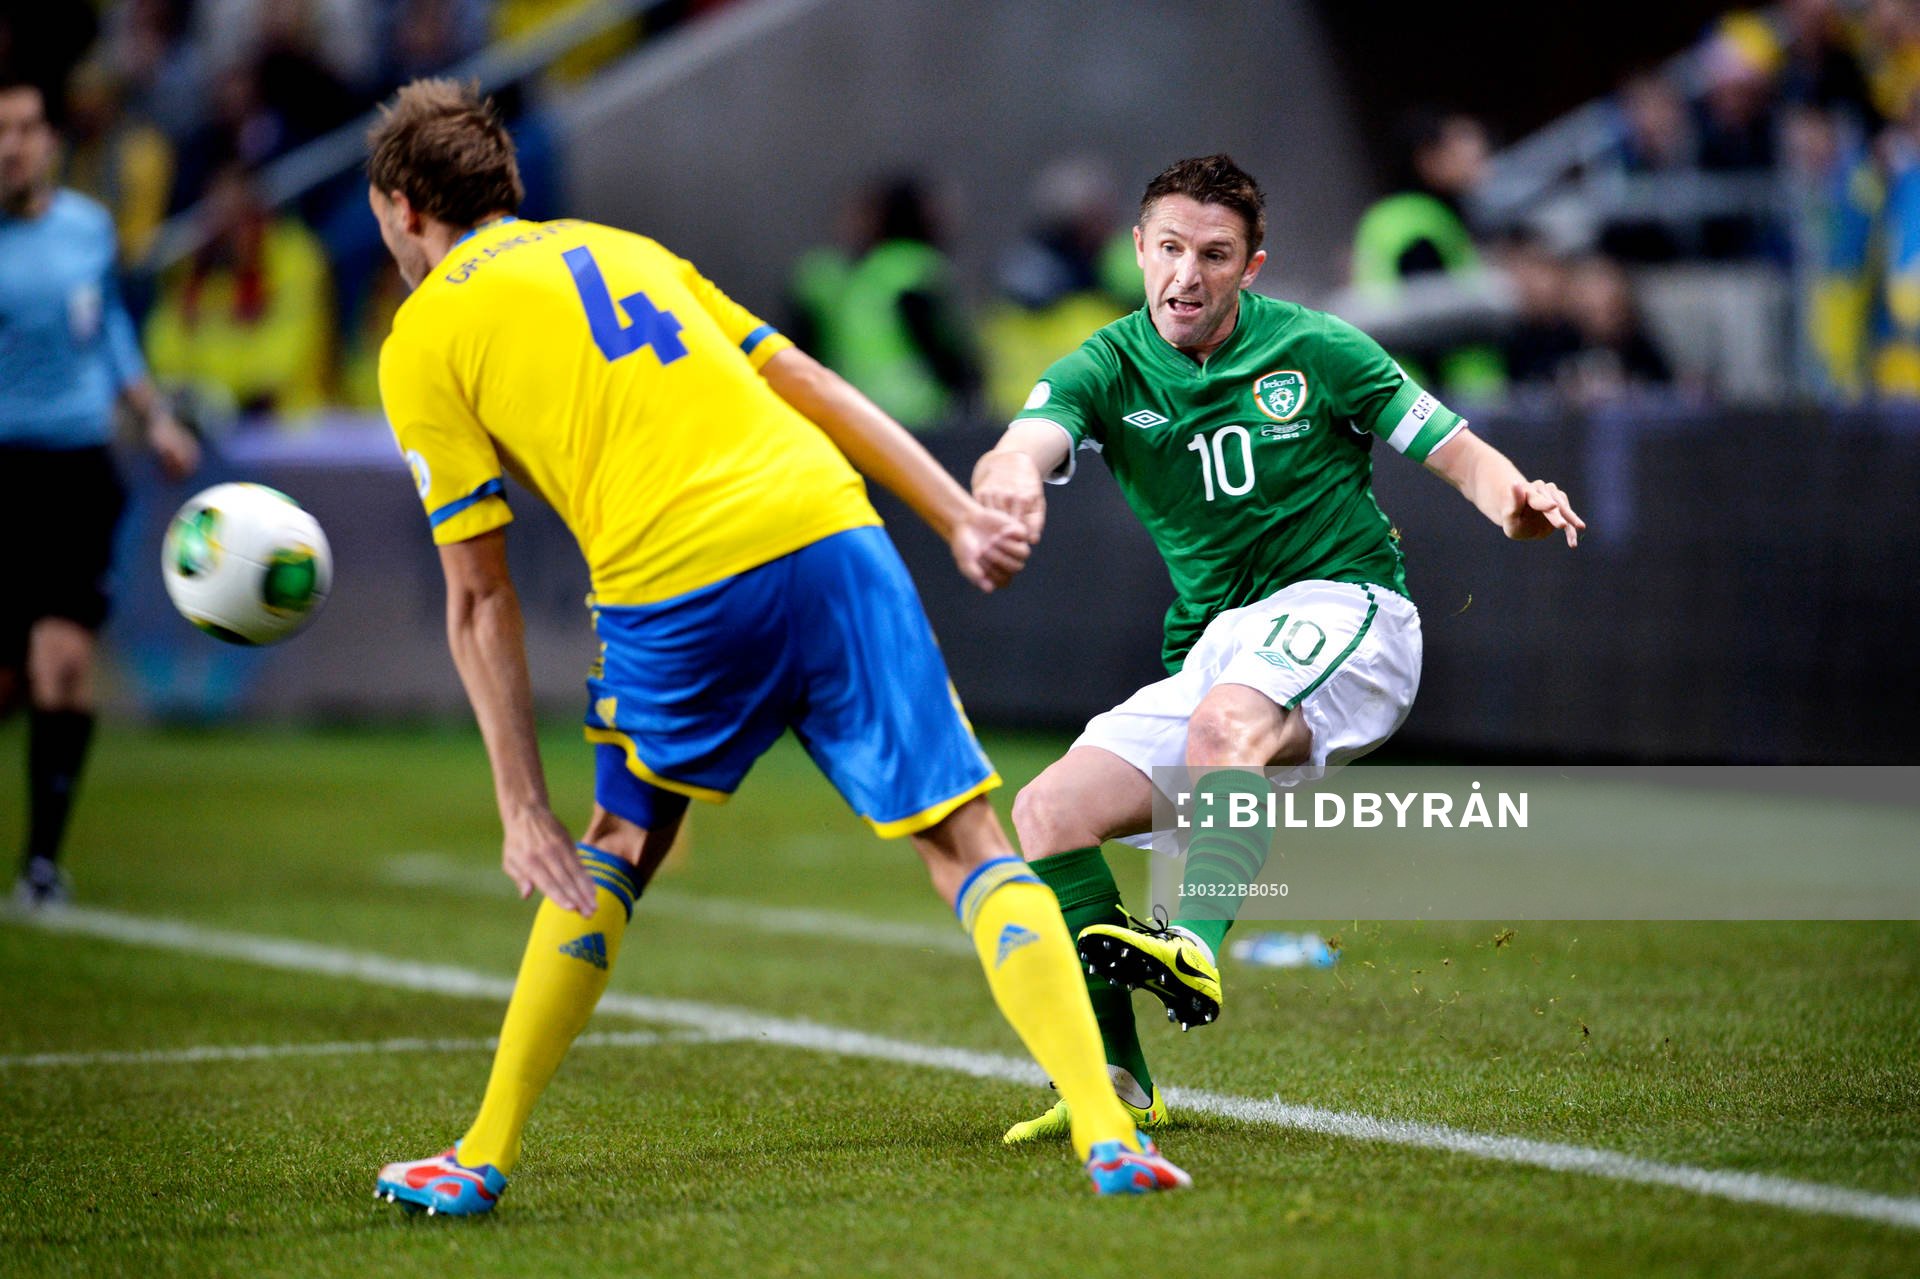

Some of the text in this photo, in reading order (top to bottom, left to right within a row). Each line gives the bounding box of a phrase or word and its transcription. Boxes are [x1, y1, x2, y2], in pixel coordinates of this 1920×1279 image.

[561, 245, 690, 367] 4
[1187, 425, 1256, 501] 10
[1263, 613, 1327, 666] 10
